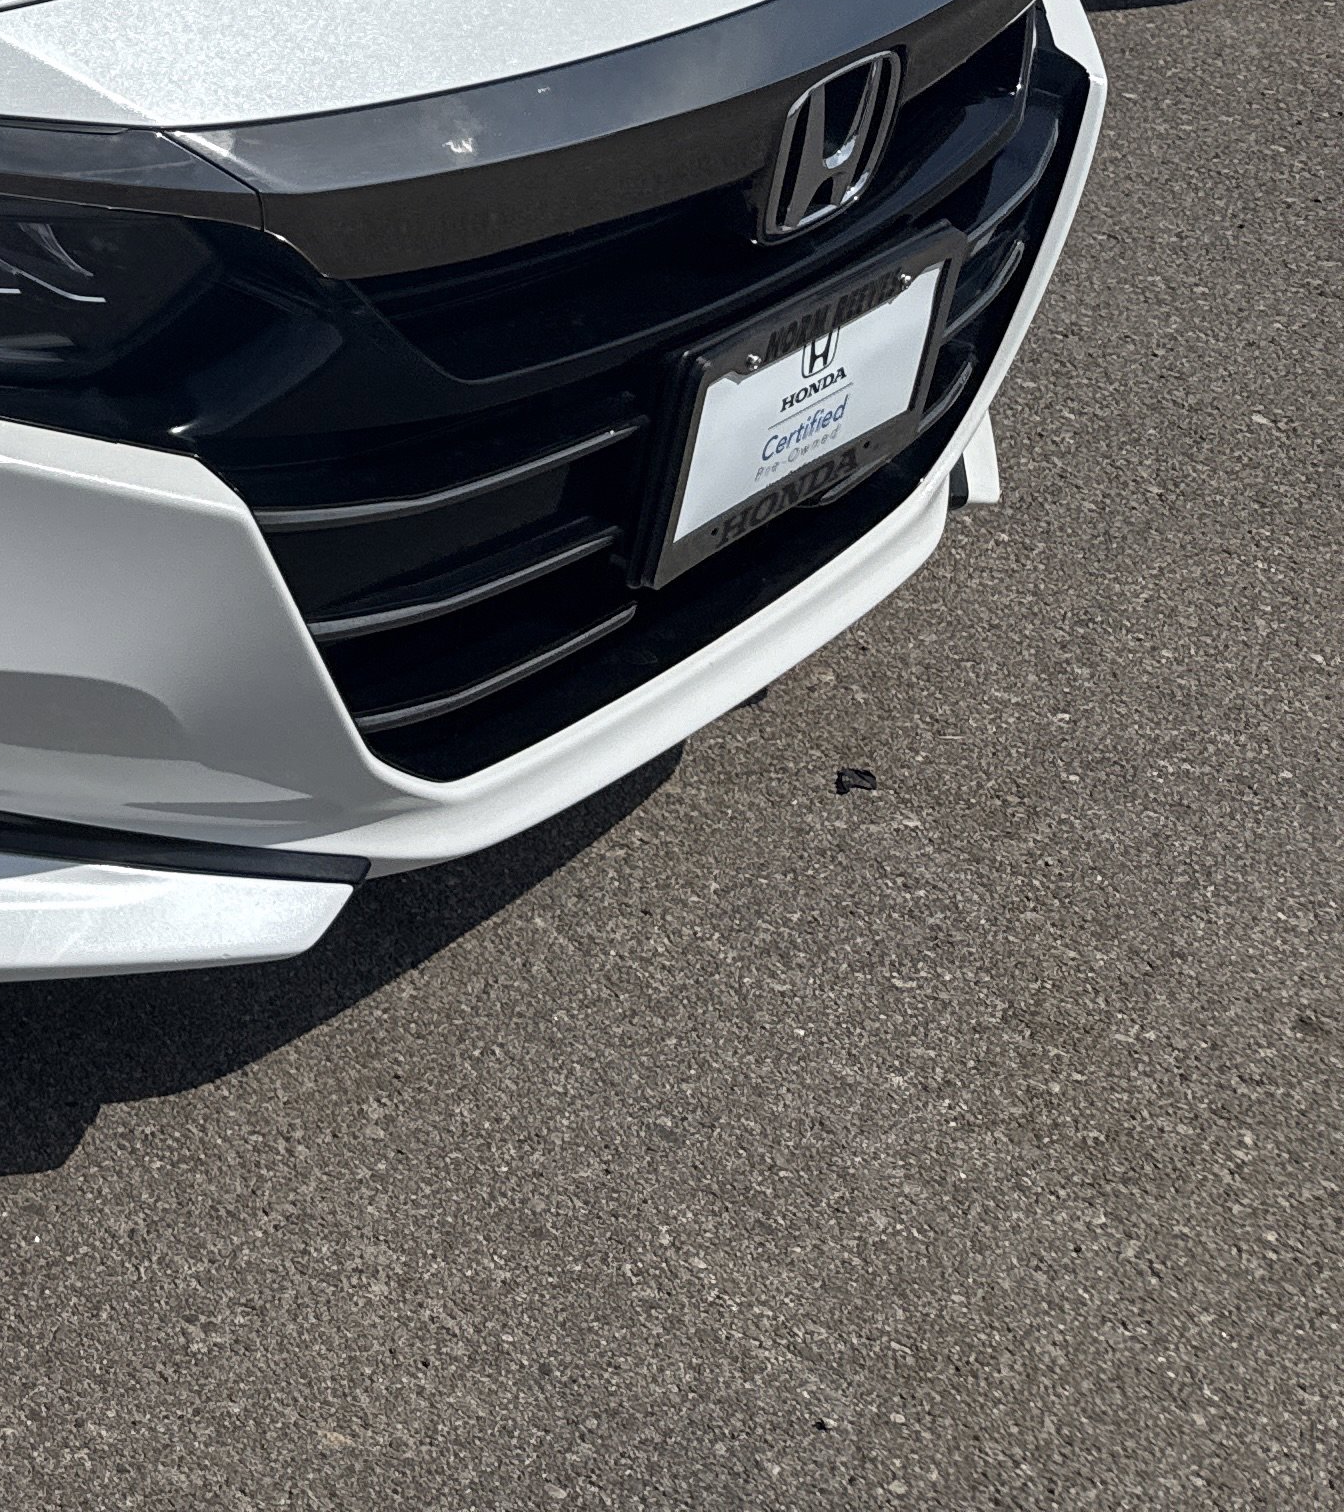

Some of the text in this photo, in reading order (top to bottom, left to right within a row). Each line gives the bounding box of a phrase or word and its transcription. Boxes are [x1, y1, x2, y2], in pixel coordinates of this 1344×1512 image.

[780, 366, 847, 413] HONDA
[754, 424, 842, 483] Pre-Owned
[762, 394, 848, 462] Certified
[716, 447, 859, 548] HONDA
